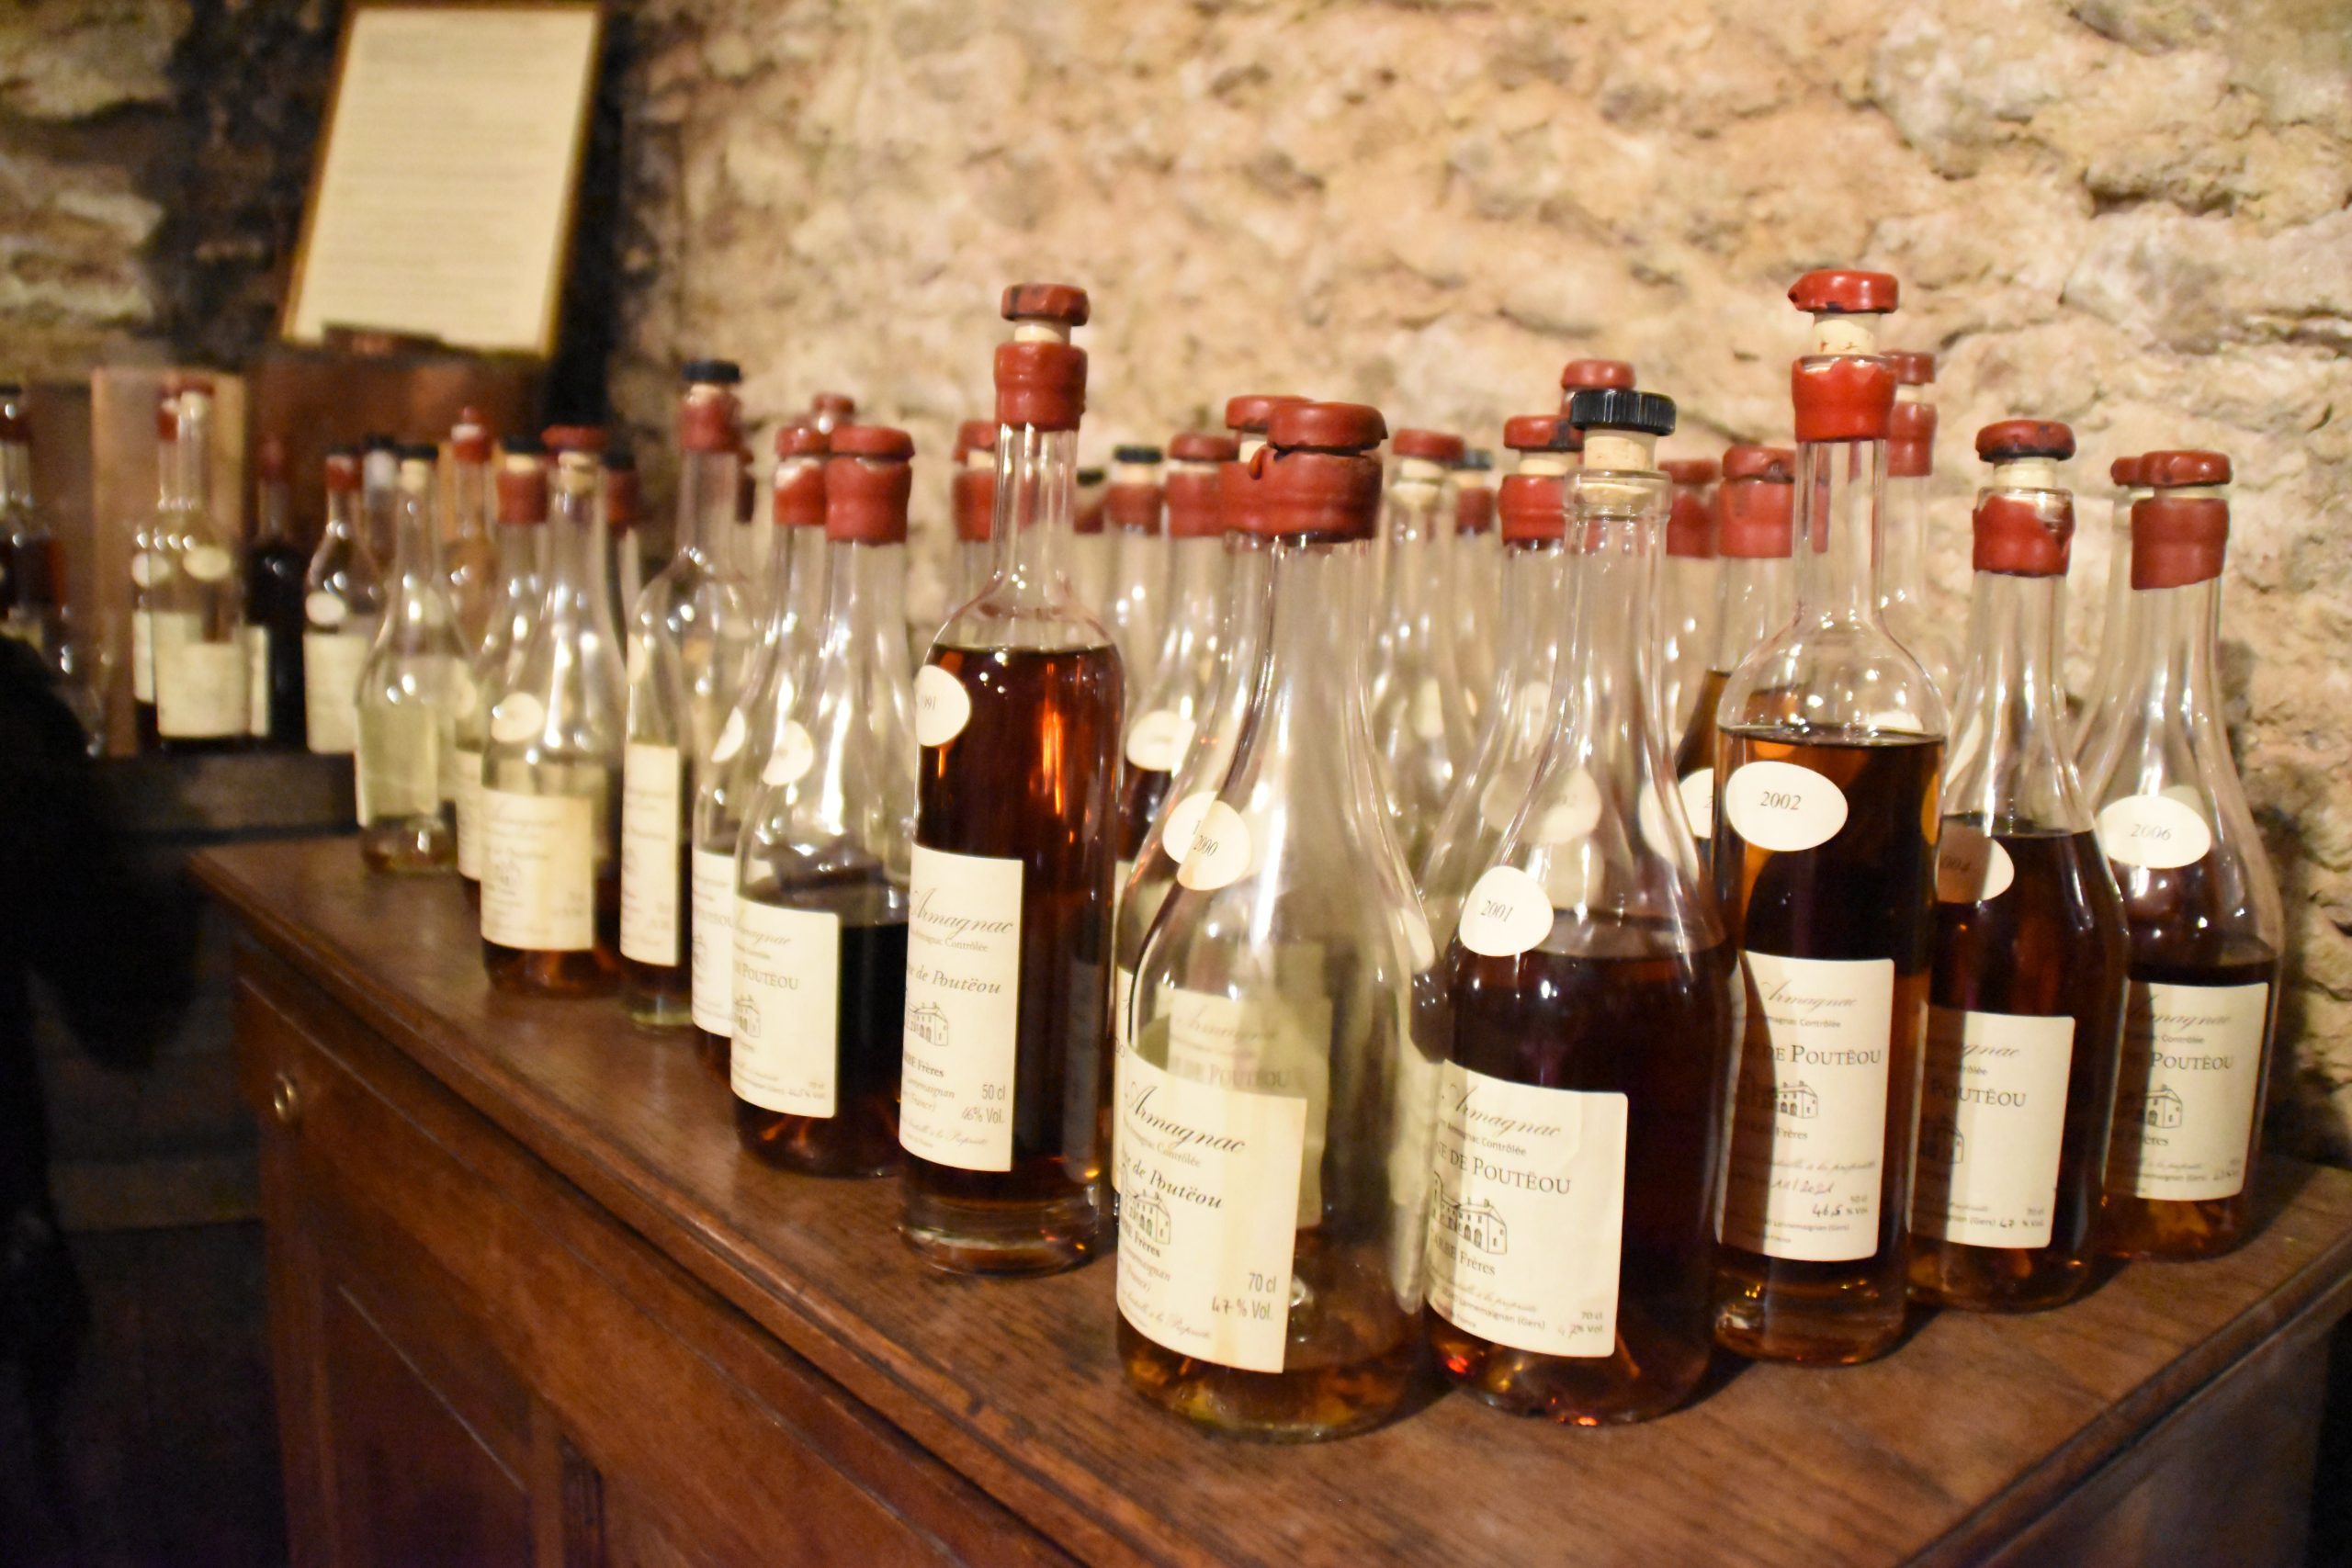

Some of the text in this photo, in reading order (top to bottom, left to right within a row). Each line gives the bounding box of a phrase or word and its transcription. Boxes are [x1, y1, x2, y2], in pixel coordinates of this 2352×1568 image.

[1759, 791, 1802, 810] 2002
[2130, 824, 2172, 840] 2006
[1193, 834, 1218, 857] 2000
[911, 886, 1013, 941] Armagnac
[1480, 899, 1514, 922] 2001
[916, 964, 929, 980] de
[981, 1084, 1006, 1101] 50 cl
[986, 1108, 1005, 1124] Vol.
[1126, 1081, 1246, 1152] Armagnac
[1442, 1084, 1560, 1139] Armagnac
[2145, 1134, 2169, 1146] ères
[1450, 1148, 1467, 1171] DE
[1472, 1156, 1571, 1195] POUTËOU
[1132, 1159, 1223, 1210] de Poutëou
[1459, 1250, 1496, 1275] Frères
[1249, 1272, 1276, 1294] 70 cl
[1251, 1301, 1272, 1321] Vol.
